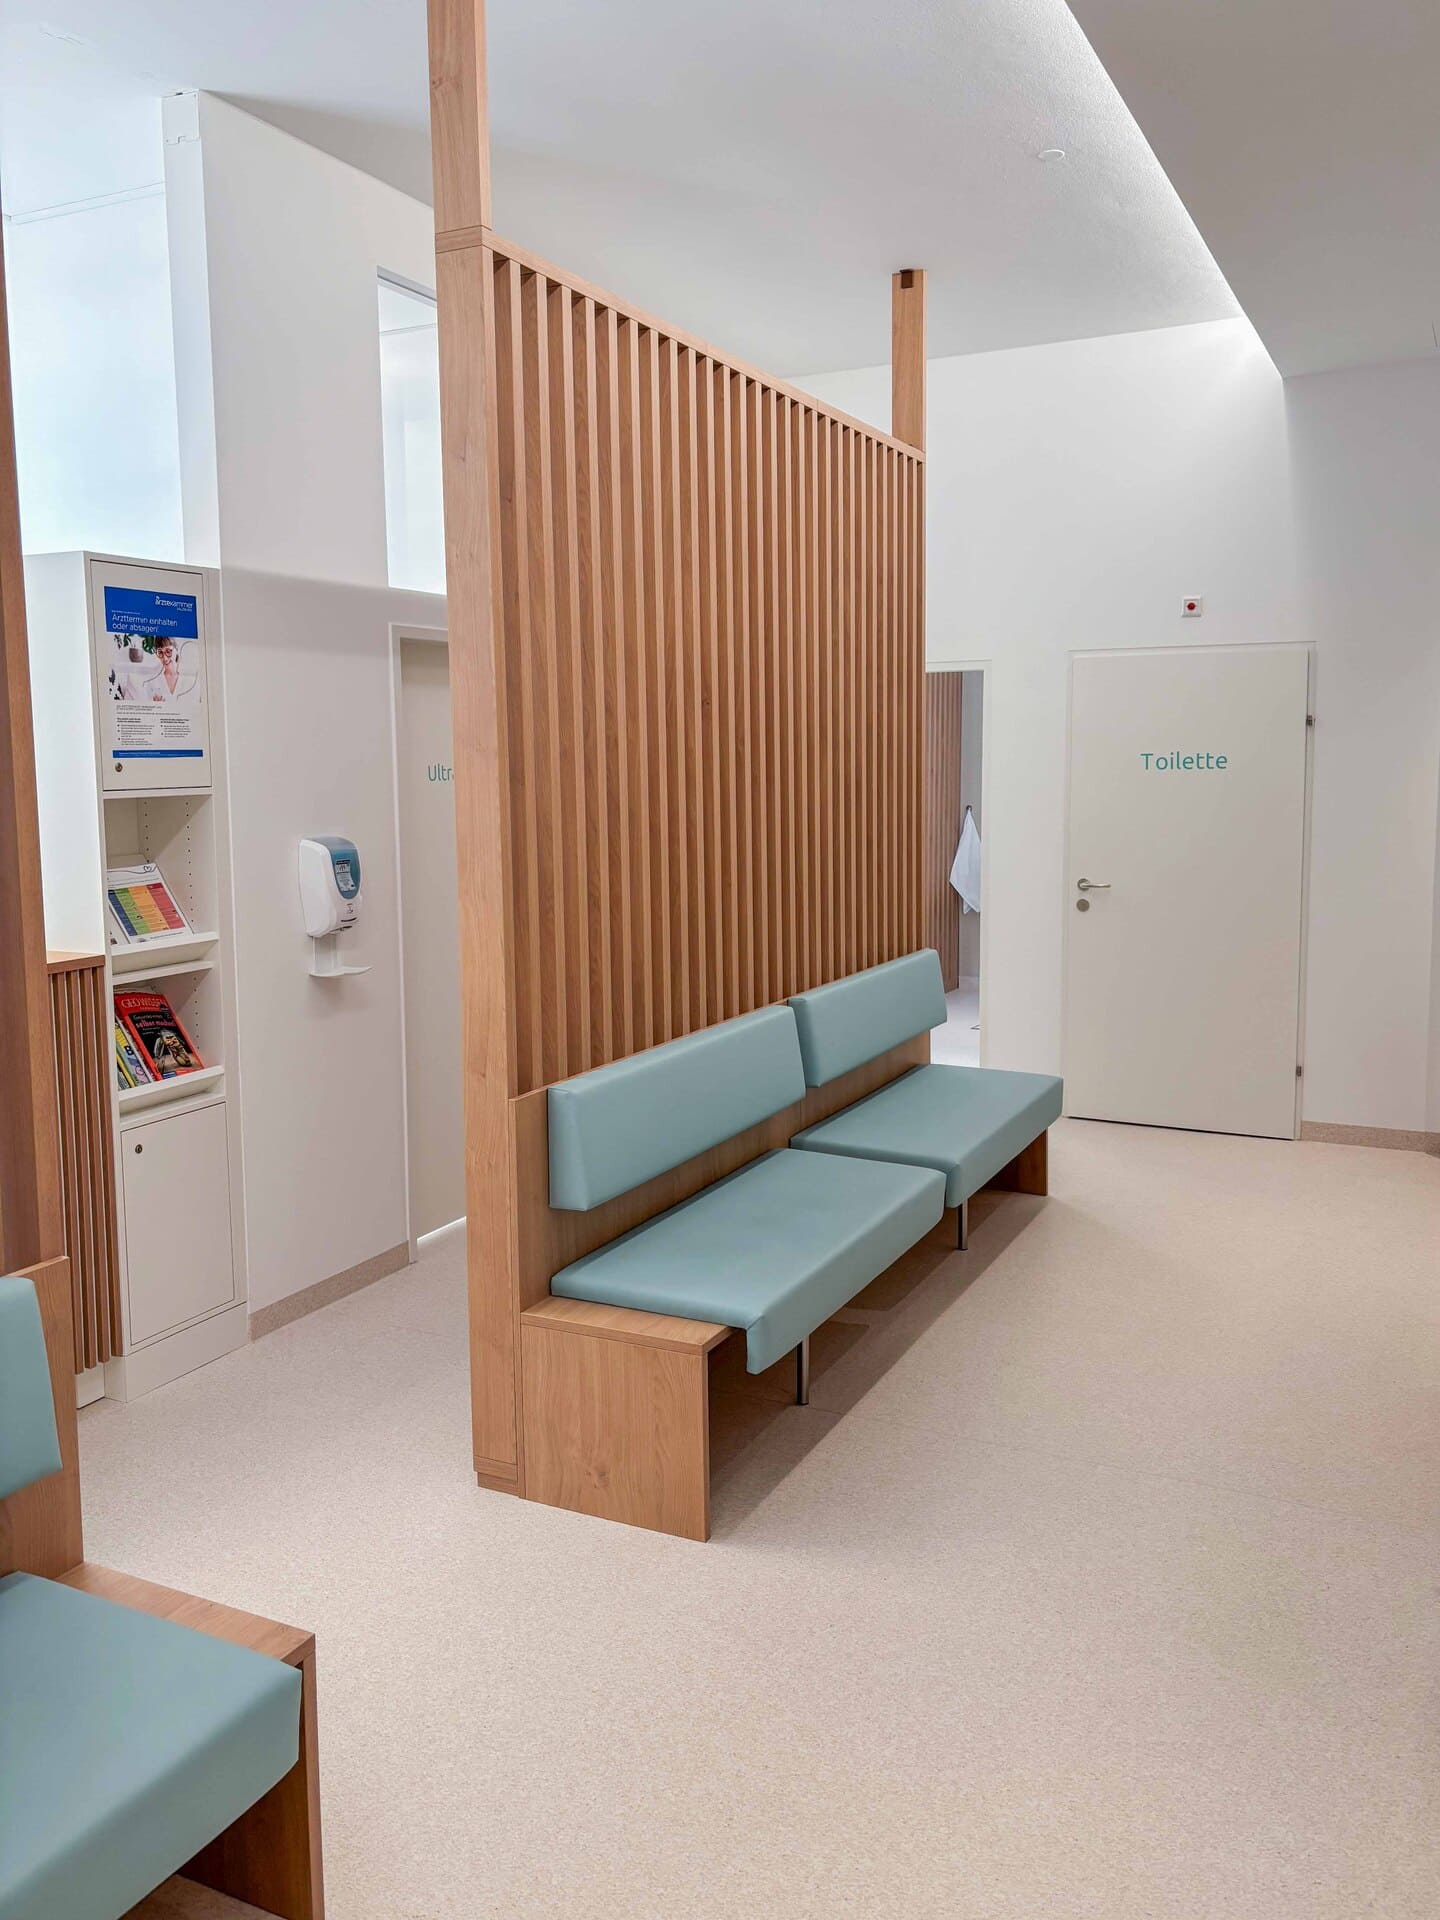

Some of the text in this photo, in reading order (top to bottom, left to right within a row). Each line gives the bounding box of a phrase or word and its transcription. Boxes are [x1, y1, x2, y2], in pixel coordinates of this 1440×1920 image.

[112, 614, 178, 627] Arzttermin einhalten
[112, 622, 128, 630] oder
[1140, 751, 1228, 770] Toilette
